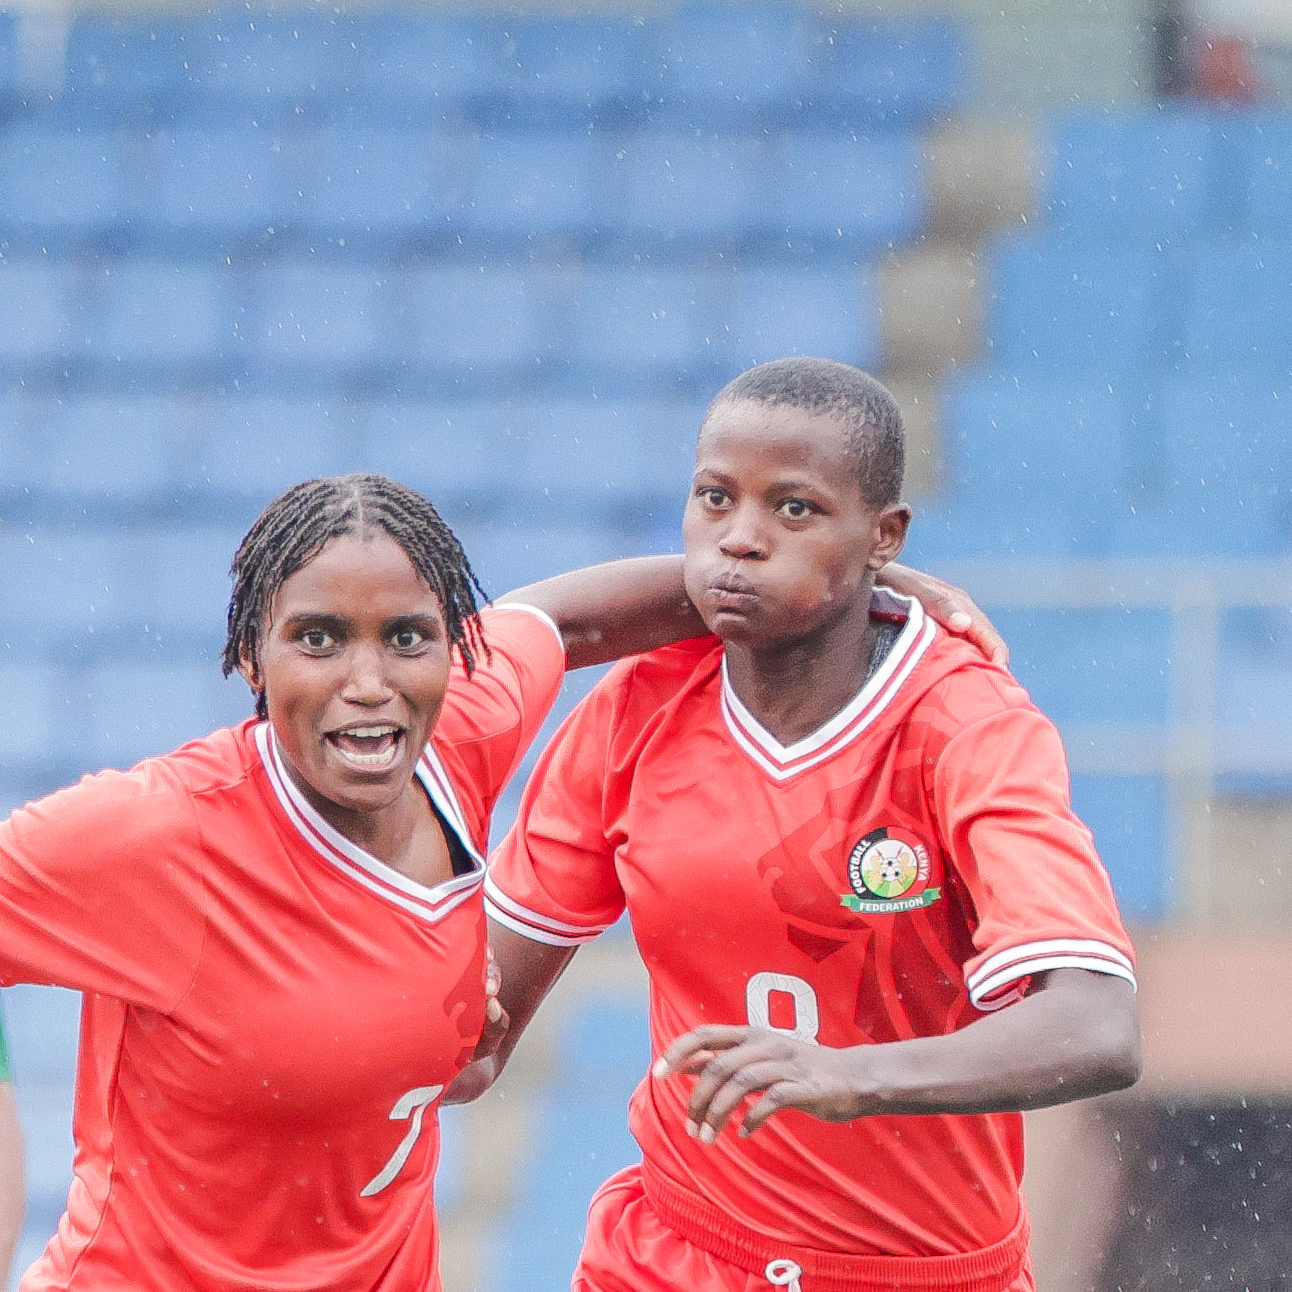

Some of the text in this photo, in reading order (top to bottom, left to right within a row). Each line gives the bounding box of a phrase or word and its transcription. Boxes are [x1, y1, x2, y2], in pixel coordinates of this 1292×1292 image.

[849, 839, 872, 895] FOOTBALL
[913, 844, 928, 882] KENYA
[859, 896, 924, 912] FEDERATION
[359, 1083, 445, 1198] 7
